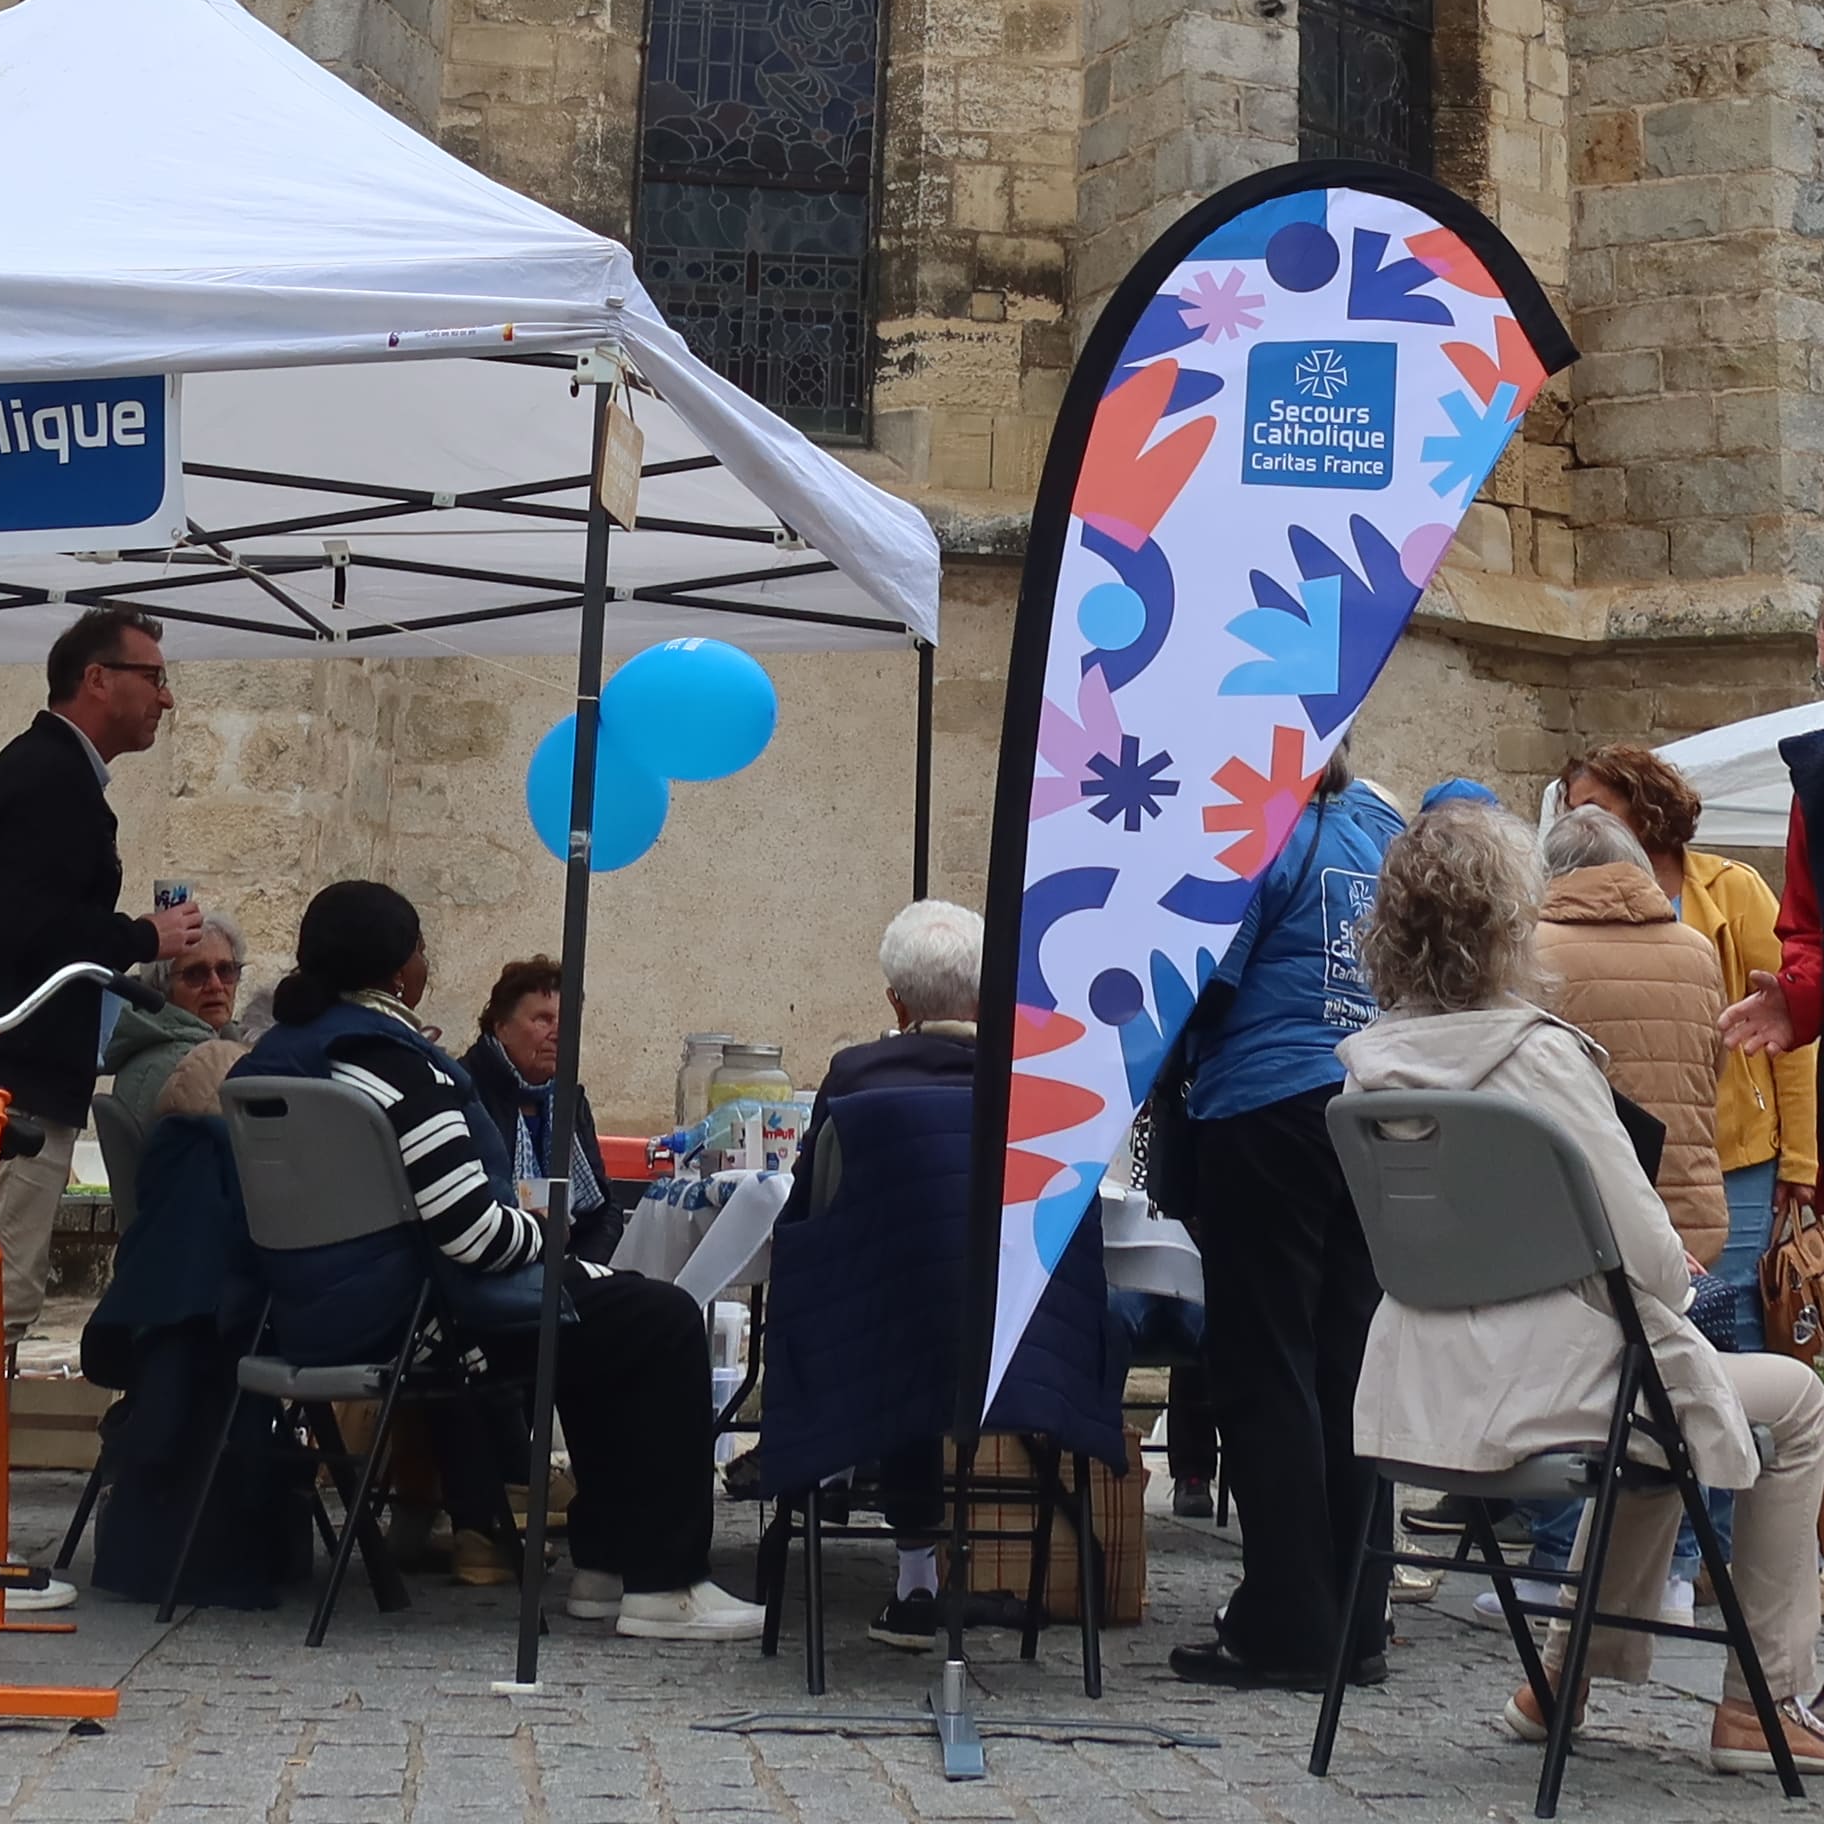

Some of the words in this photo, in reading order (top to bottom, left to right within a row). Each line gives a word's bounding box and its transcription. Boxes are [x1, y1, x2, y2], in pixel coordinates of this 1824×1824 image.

[1269, 399, 1370, 424] Secours
[1253, 422, 1385, 453] Catholique
[1251, 452, 1317, 472] Caritas
[1324, 455, 1384, 475] France
